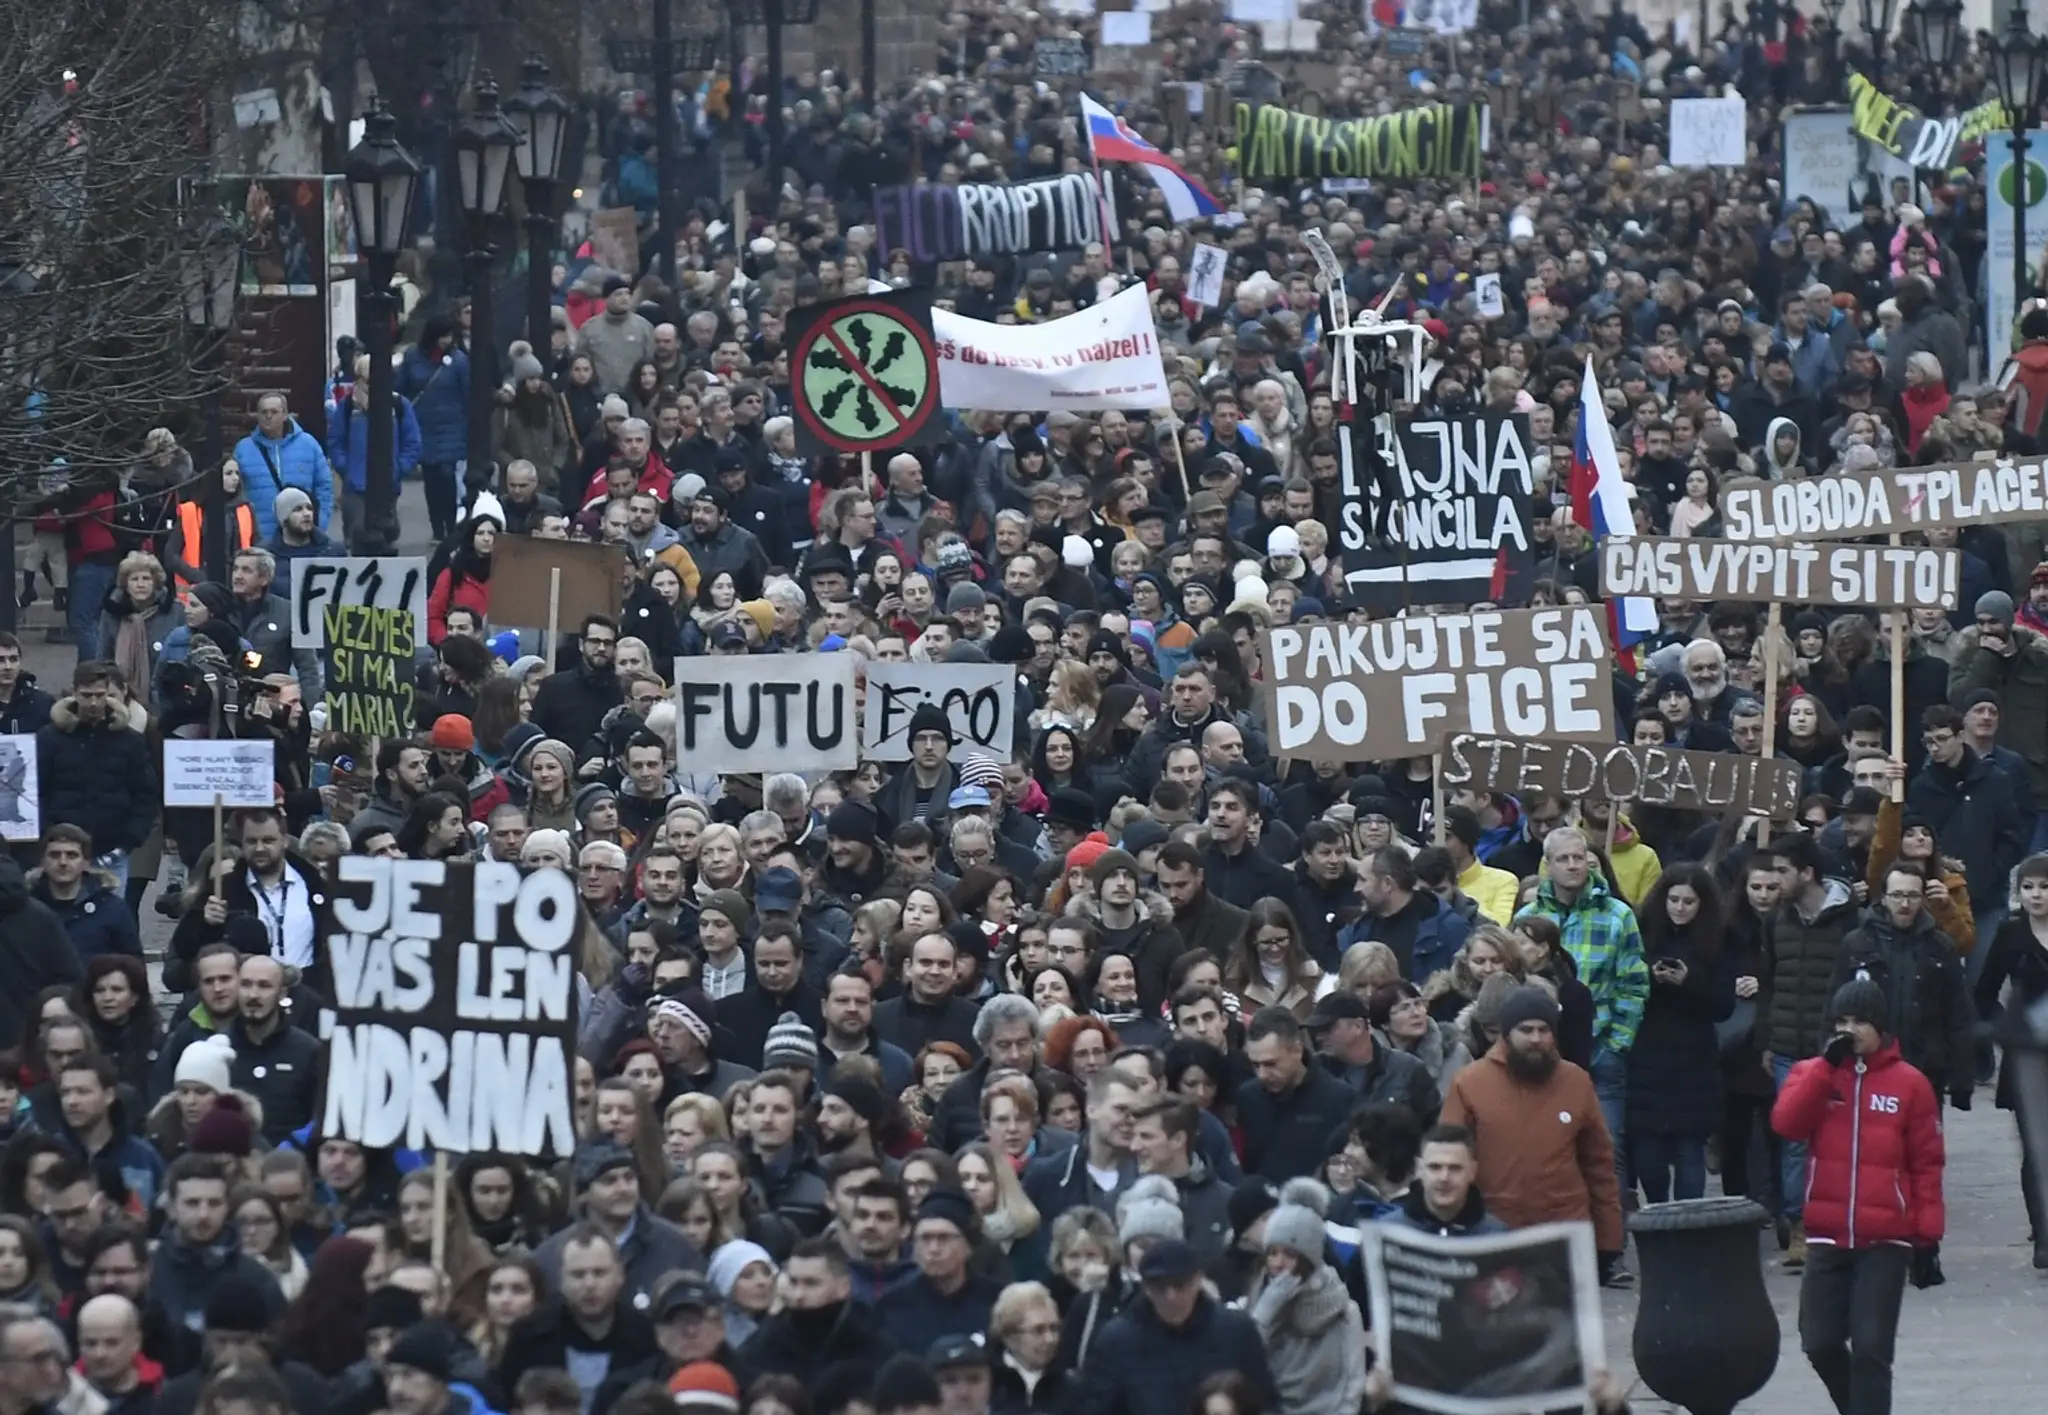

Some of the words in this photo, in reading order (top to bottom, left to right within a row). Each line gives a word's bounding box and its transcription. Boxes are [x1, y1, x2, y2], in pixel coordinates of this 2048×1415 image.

[1726, 475, 1892, 540] SLOBODA
[1606, 534, 1682, 594] ČAS
[1688, 542, 1819, 599] VYPIŤ
[1830, 548, 1877, 603] SI
[1883, 549, 1957, 607] TO!
[323, 603, 415, 658] VEZMEŠ
[1270, 613, 1506, 680] PAKUJTE
[1531, 609, 1605, 662] SA
[333, 648, 354, 683] SI
[363, 653, 398, 694] MA
[1276, 682, 1368, 749] DO
[1402, 663, 1601, 743] FICE
[682, 679, 844, 751] FUTU
[333, 855, 446, 940] JE
[473, 862, 577, 952] PO
[457, 942, 572, 1021] LEN
[1870, 1093, 1900, 1114] NS
